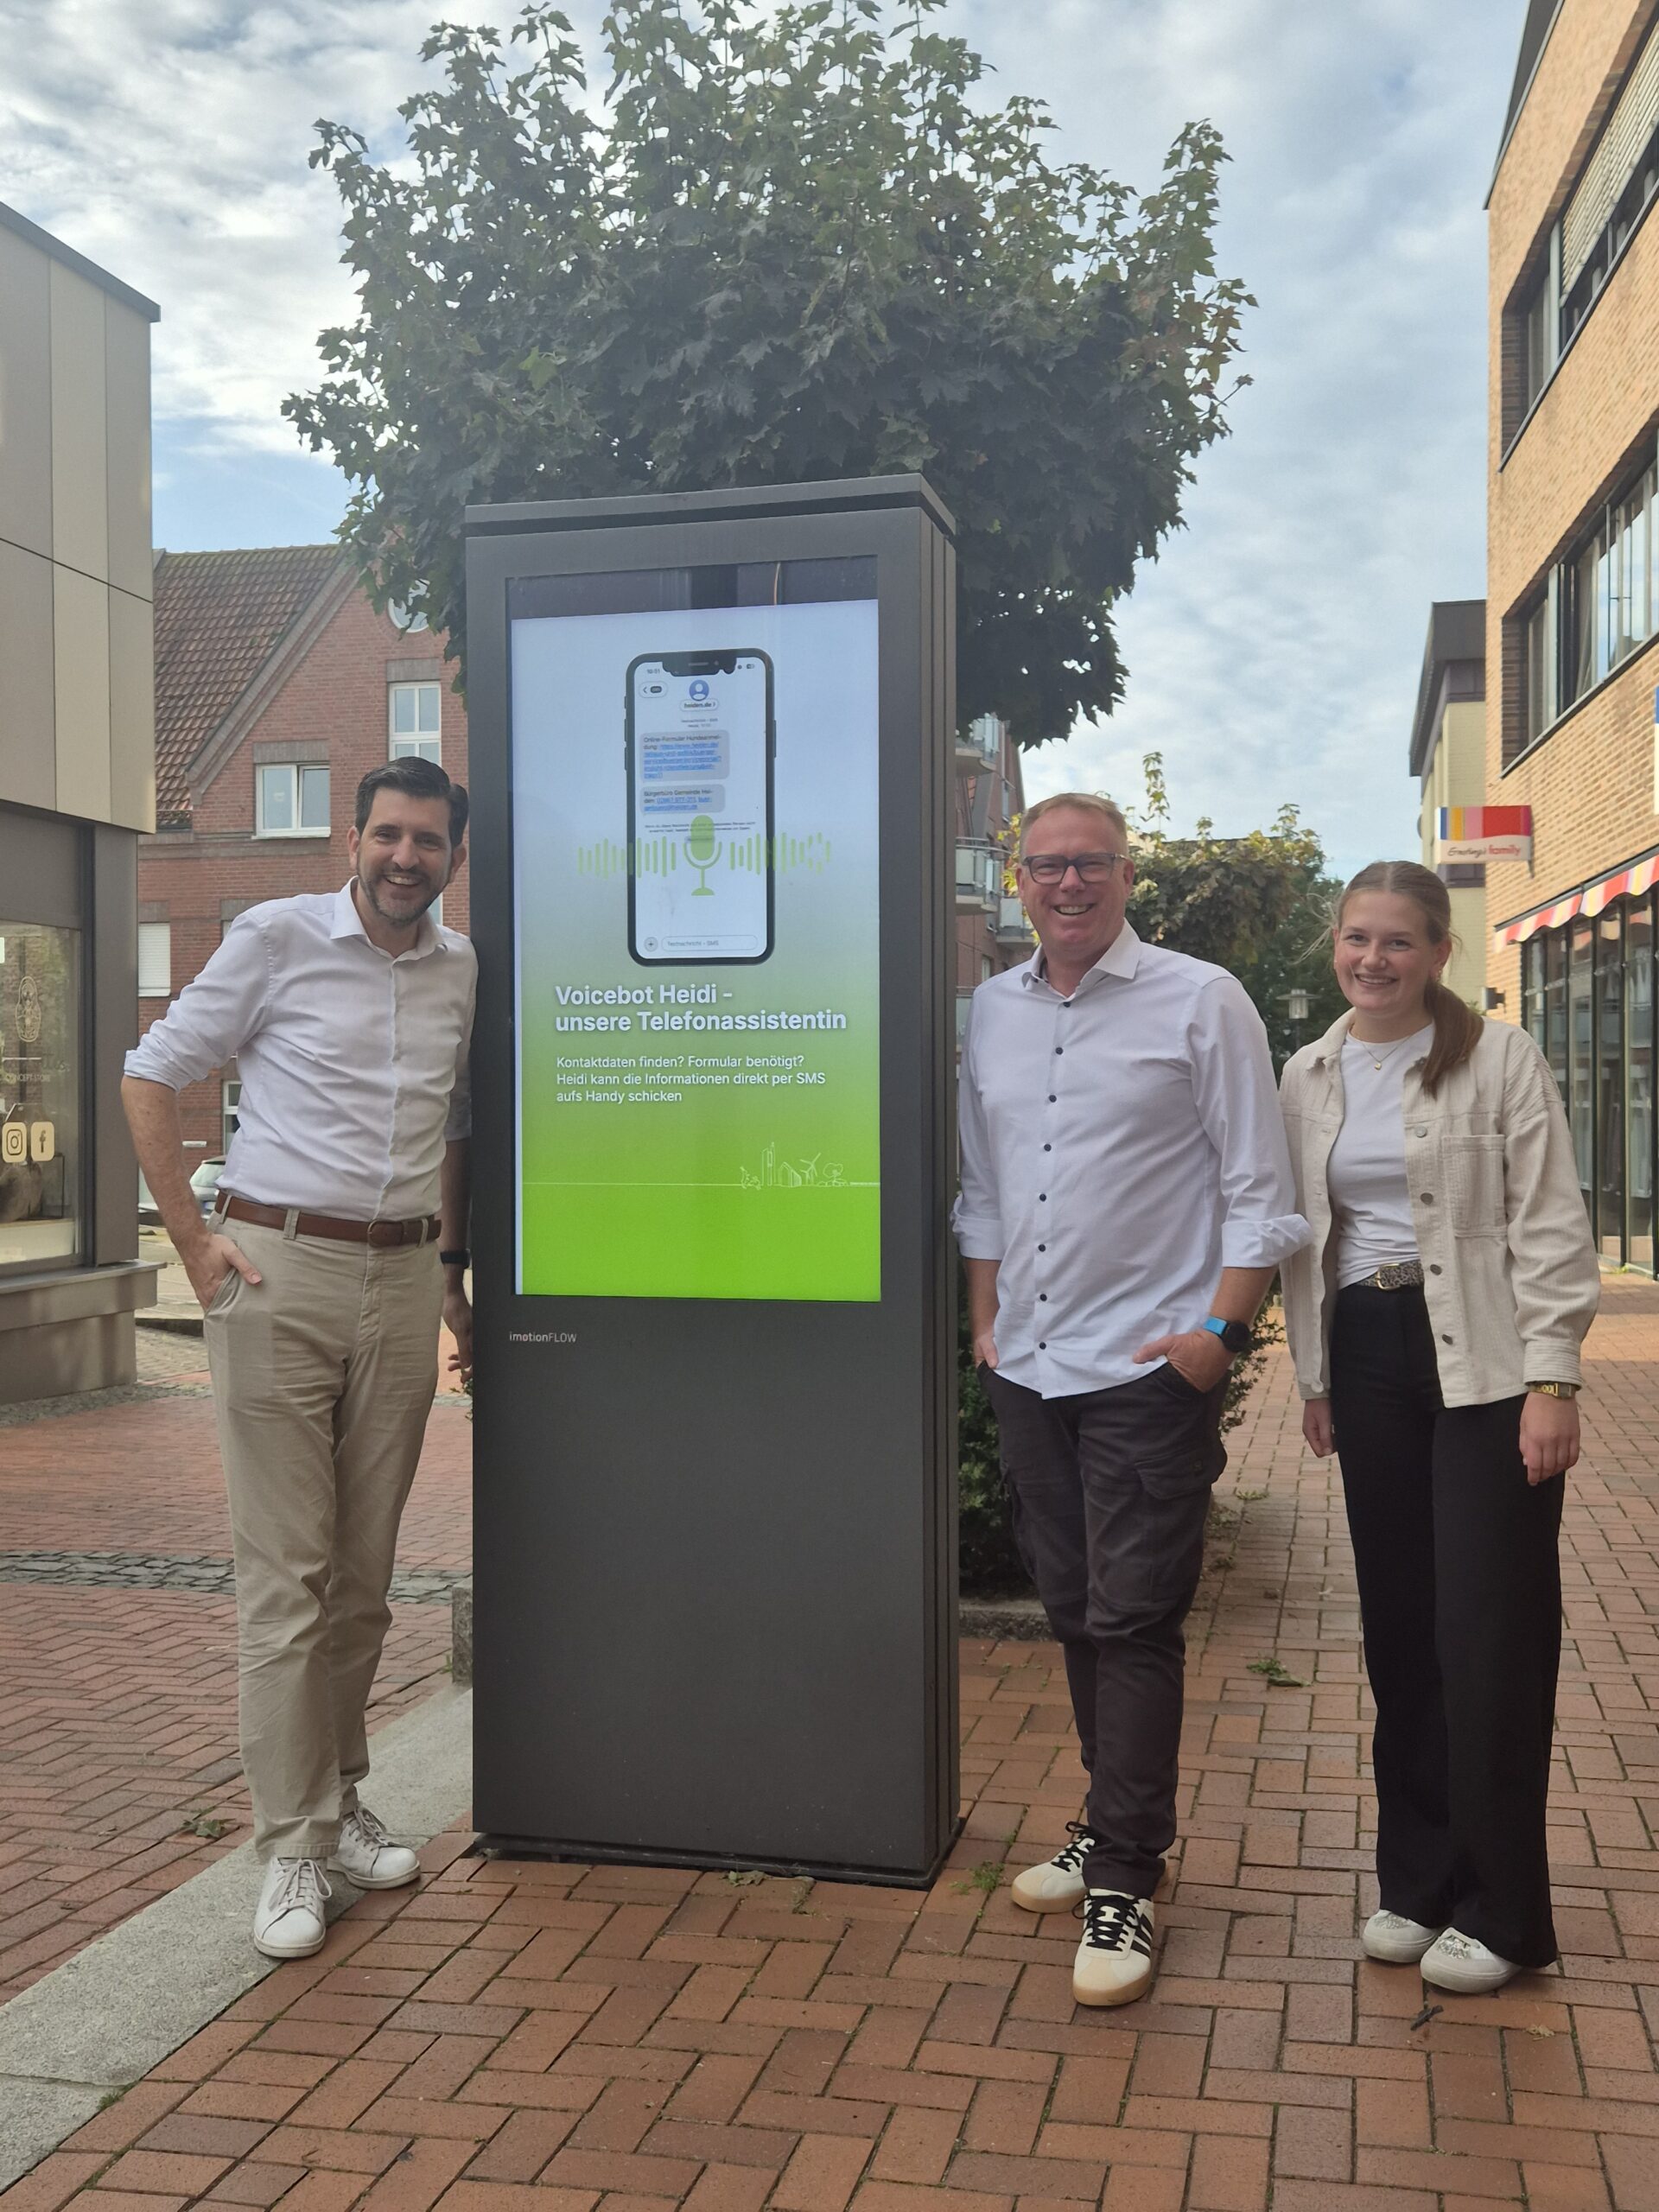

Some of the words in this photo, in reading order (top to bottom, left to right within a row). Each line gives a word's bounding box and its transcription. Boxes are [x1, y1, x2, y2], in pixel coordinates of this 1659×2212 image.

[556, 985, 654, 1006] Voicebot
[659, 983, 717, 1004] Heidi
[556, 1015, 632, 1032] unsere
[637, 1008, 847, 1032] Telefonassistentin
[556, 1057, 636, 1069] Kontaktdaten
[639, 1056, 683, 1068] finden?
[688, 1056, 741, 1068] Formular
[746, 1055, 804, 1071] benötigt?
[556, 1074, 588, 1086] Heidi
[591, 1074, 620, 1085] kann
[623, 1073, 642, 1085] die
[645, 1073, 729, 1085] Informationen
[733, 1072, 768, 1084] direkt
[772, 1075, 793, 1087] per
[796, 1072, 826, 1084] SMS
[556, 1090, 582, 1103] aufs
[586, 1090, 625, 1105] Handy
[628, 1090, 682, 1102] schicken
